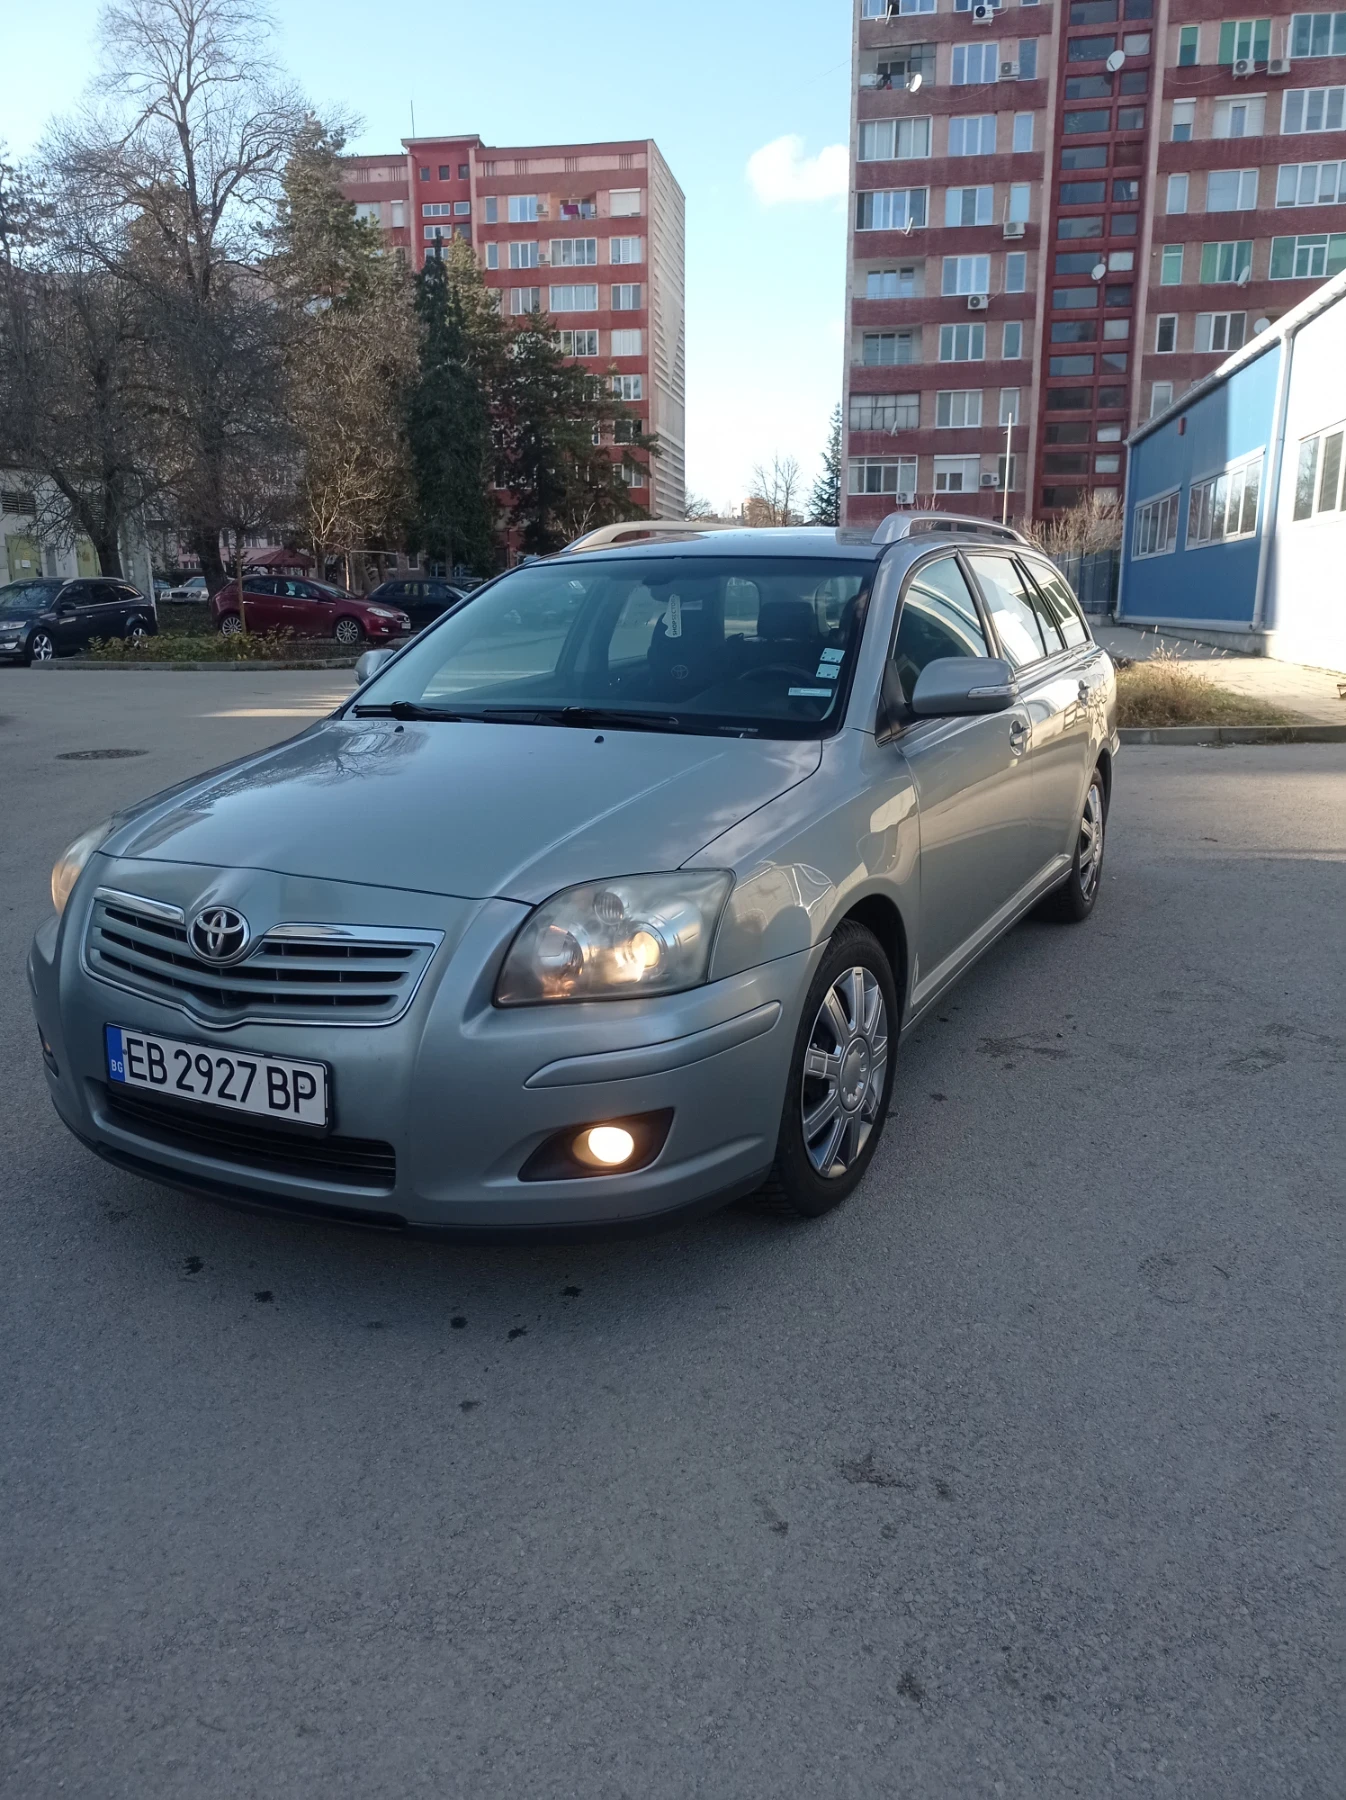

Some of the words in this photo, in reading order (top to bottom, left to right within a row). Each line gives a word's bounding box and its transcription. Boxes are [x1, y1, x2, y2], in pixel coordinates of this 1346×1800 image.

[111, 1059, 123, 1073] BG
[126, 1037, 168, 1085] EB
[174, 1048, 257, 1103] 2927
[266, 1065, 316, 1113] BP
